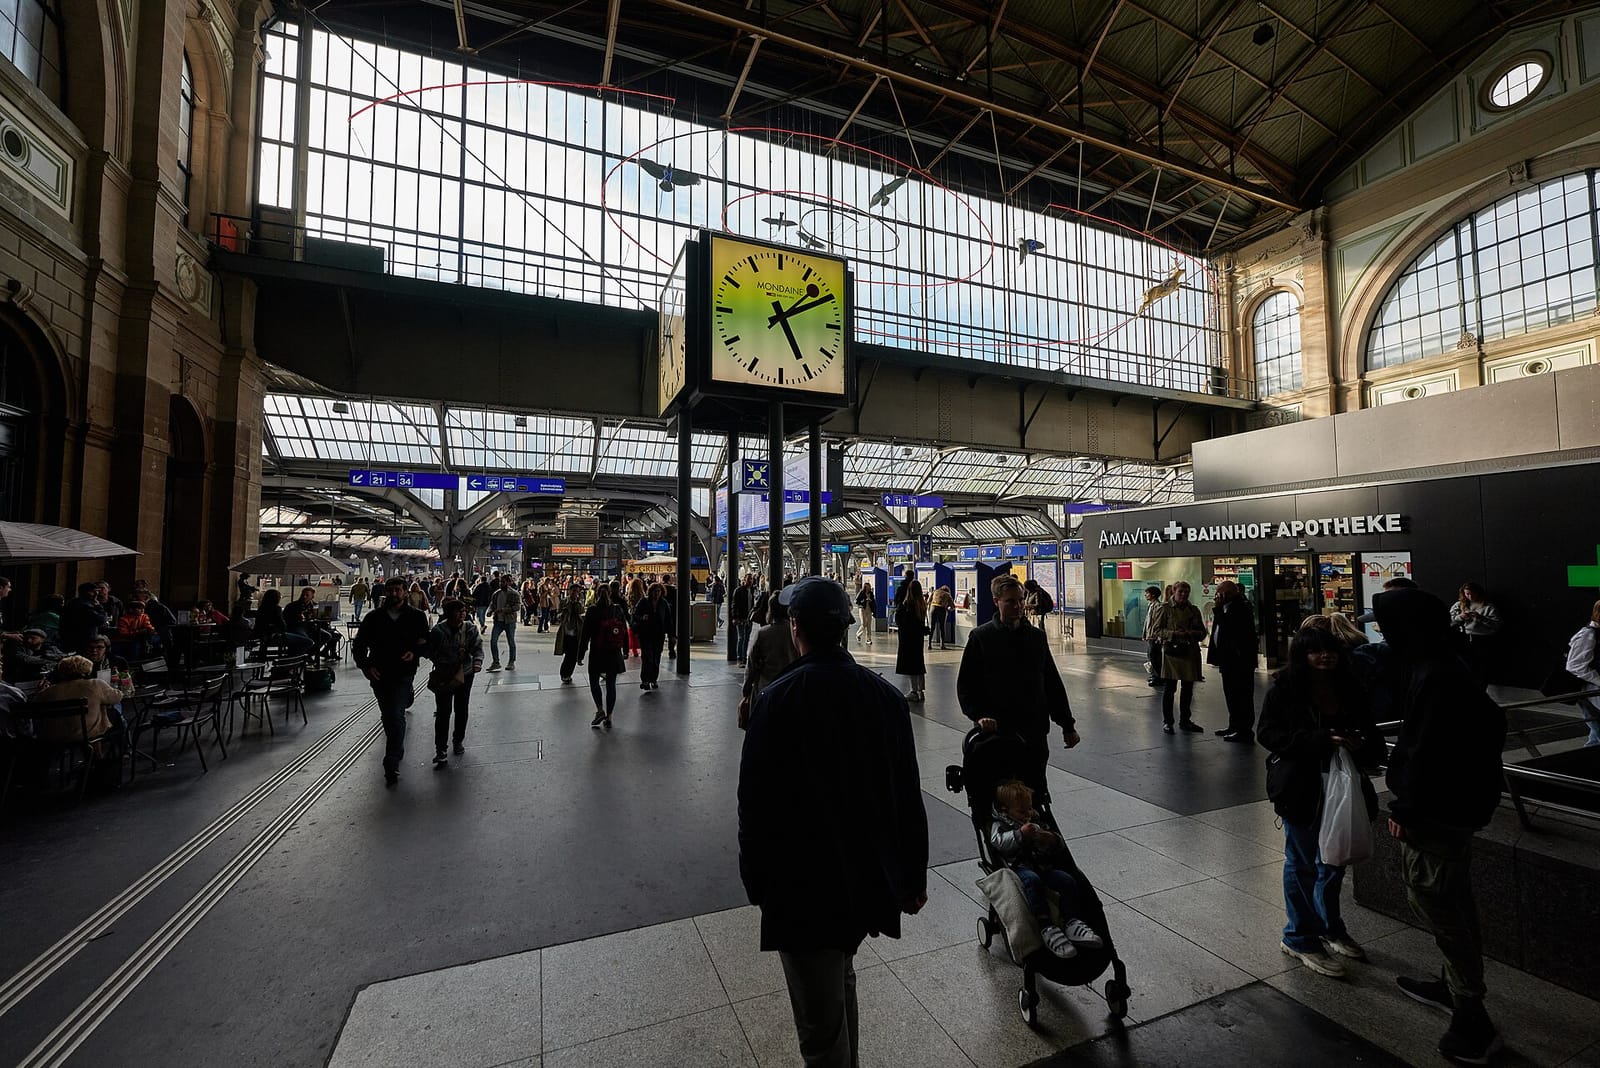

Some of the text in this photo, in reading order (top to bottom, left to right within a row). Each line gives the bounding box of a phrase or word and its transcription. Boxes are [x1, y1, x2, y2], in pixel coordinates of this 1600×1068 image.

[757, 281, 804, 296] MONDAINE
[1099, 513, 1402, 549] AMAVITA BAHNHOF APOTHEKE
